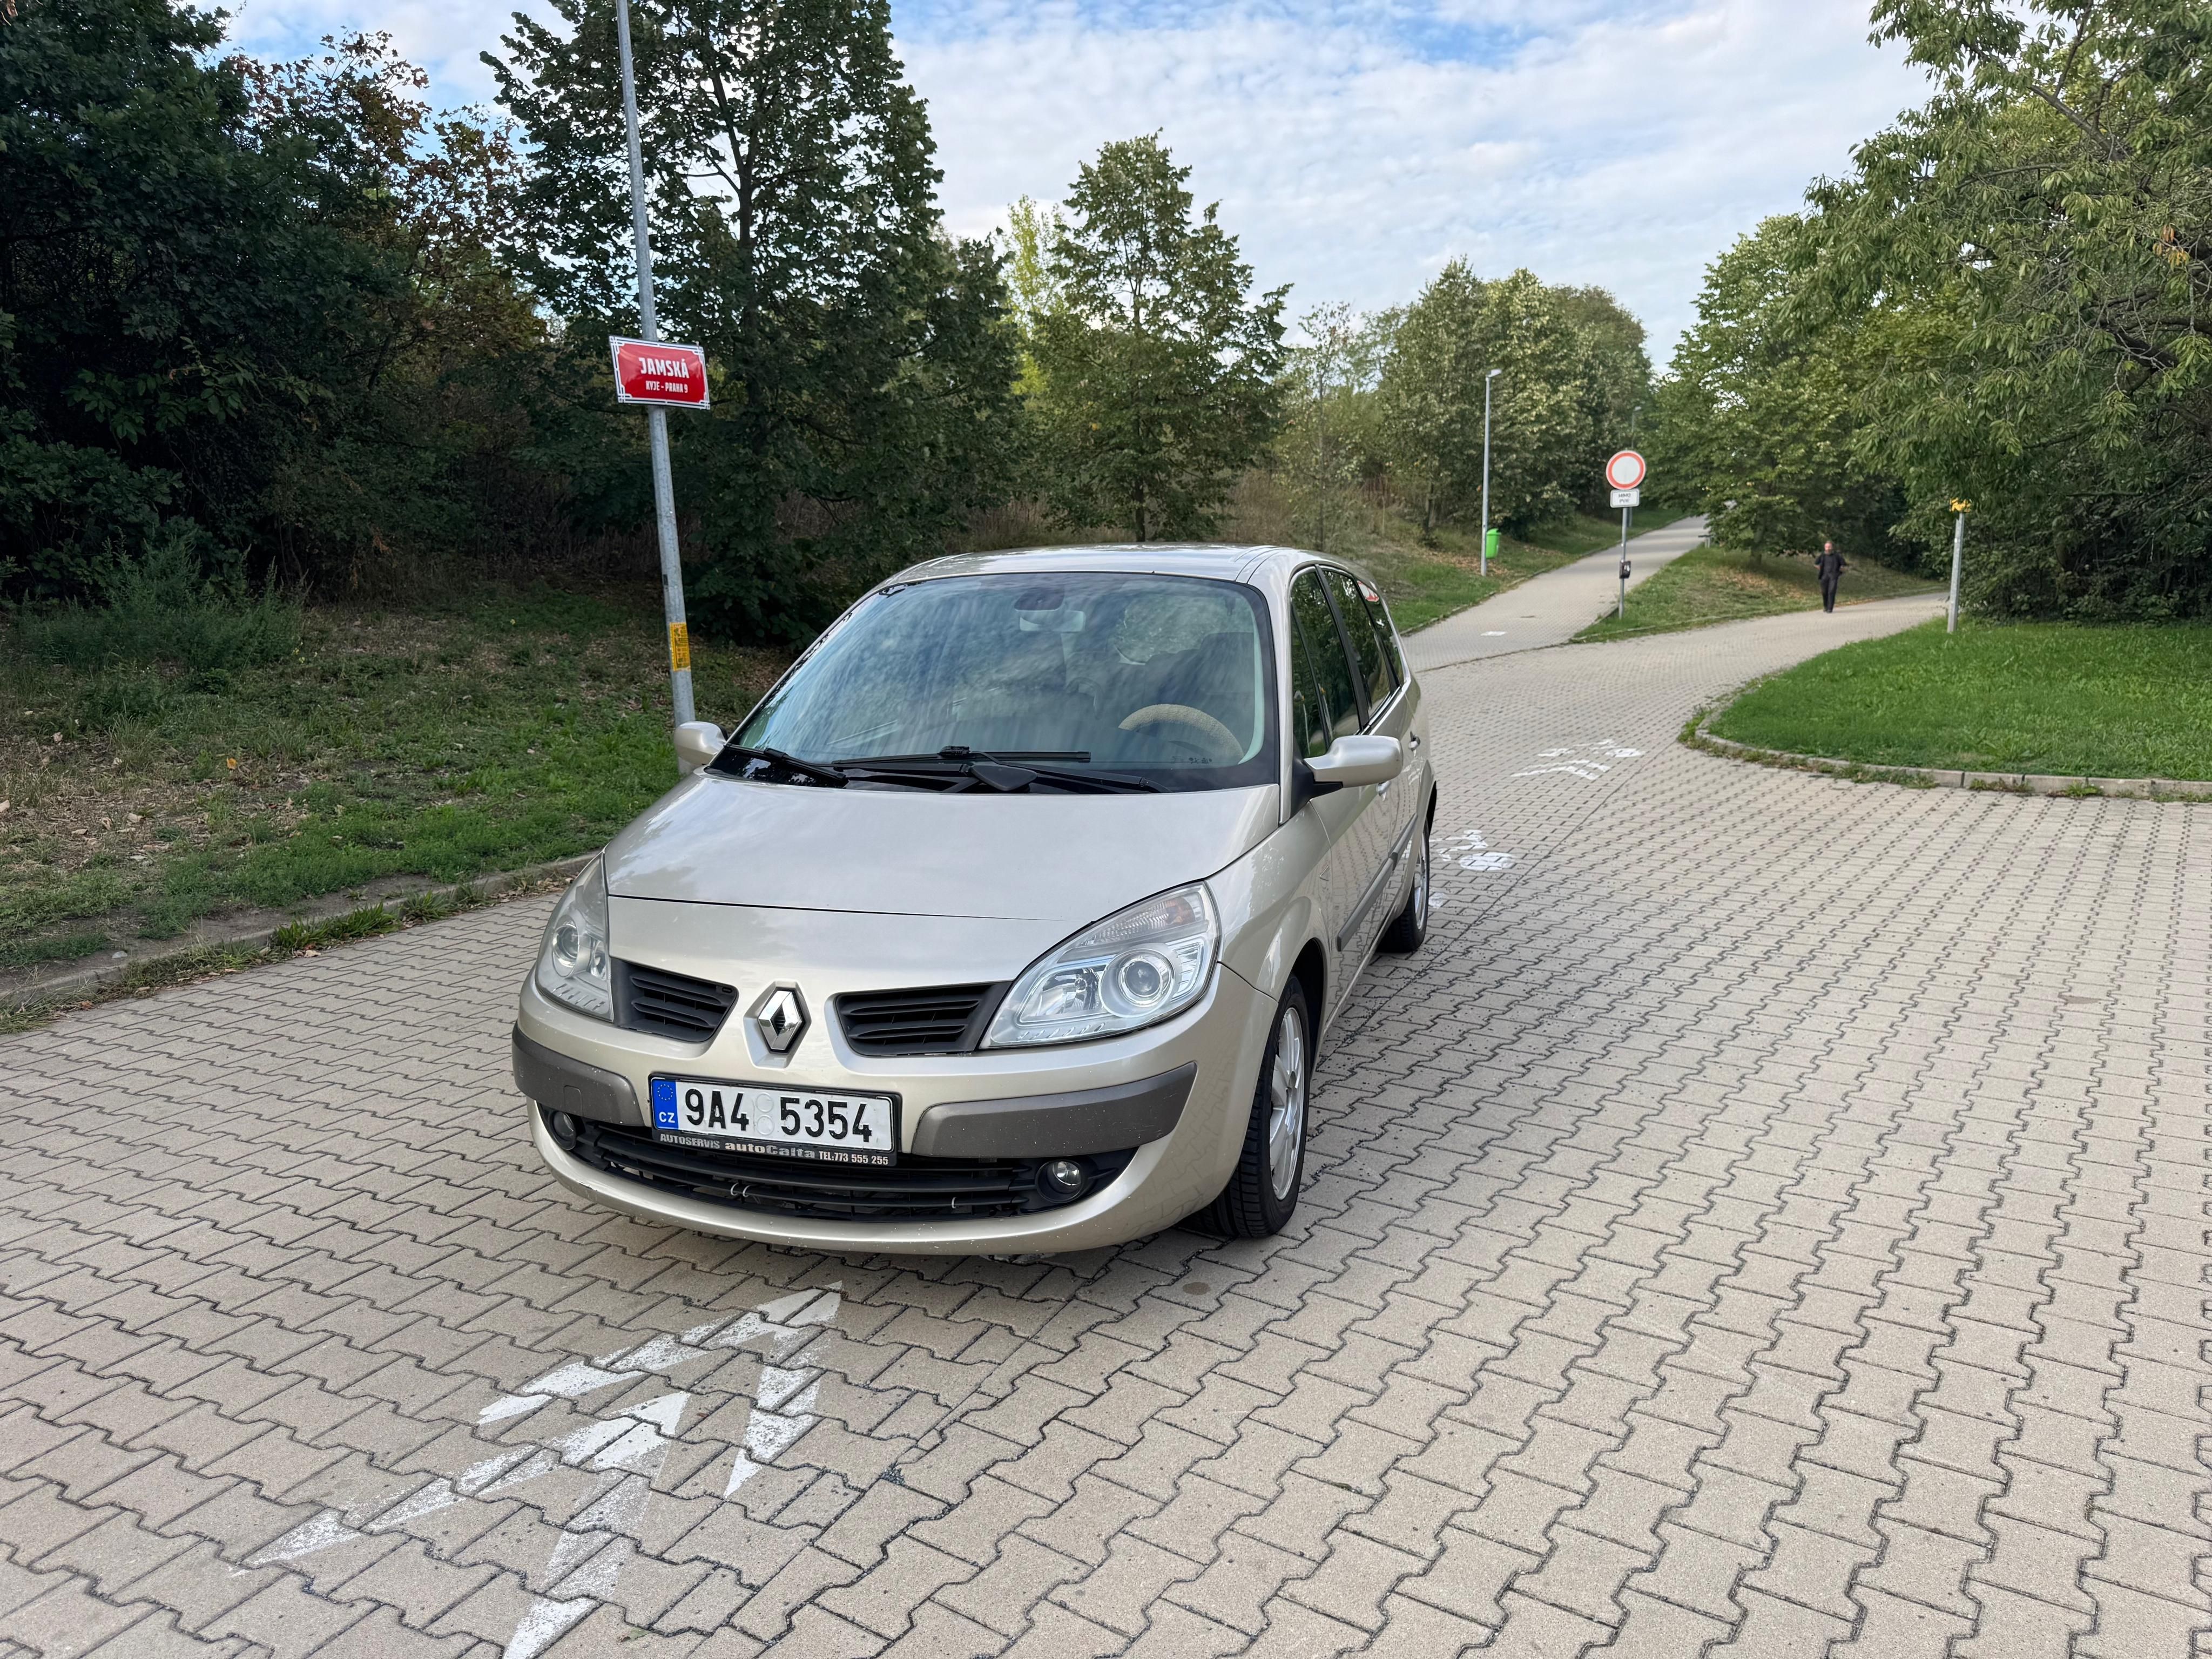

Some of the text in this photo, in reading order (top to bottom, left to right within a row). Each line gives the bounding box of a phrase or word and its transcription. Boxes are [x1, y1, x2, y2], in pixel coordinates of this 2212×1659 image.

[638, 358, 690, 379] JAMSKÁ
[646, 380, 660, 391] KYJE
[665, 382, 684, 393] PRAHA
[684, 383, 688, 393] 9
[658, 1112, 675, 1123] CZ
[685, 1088, 872, 1143] 9A4 5354
[660, 1133, 720, 1149] AUTOSERVIS
[819, 1151, 848, 1162] TEL:773
[851, 1154, 868, 1164] 555
[871, 1155, 888, 1165] 255
